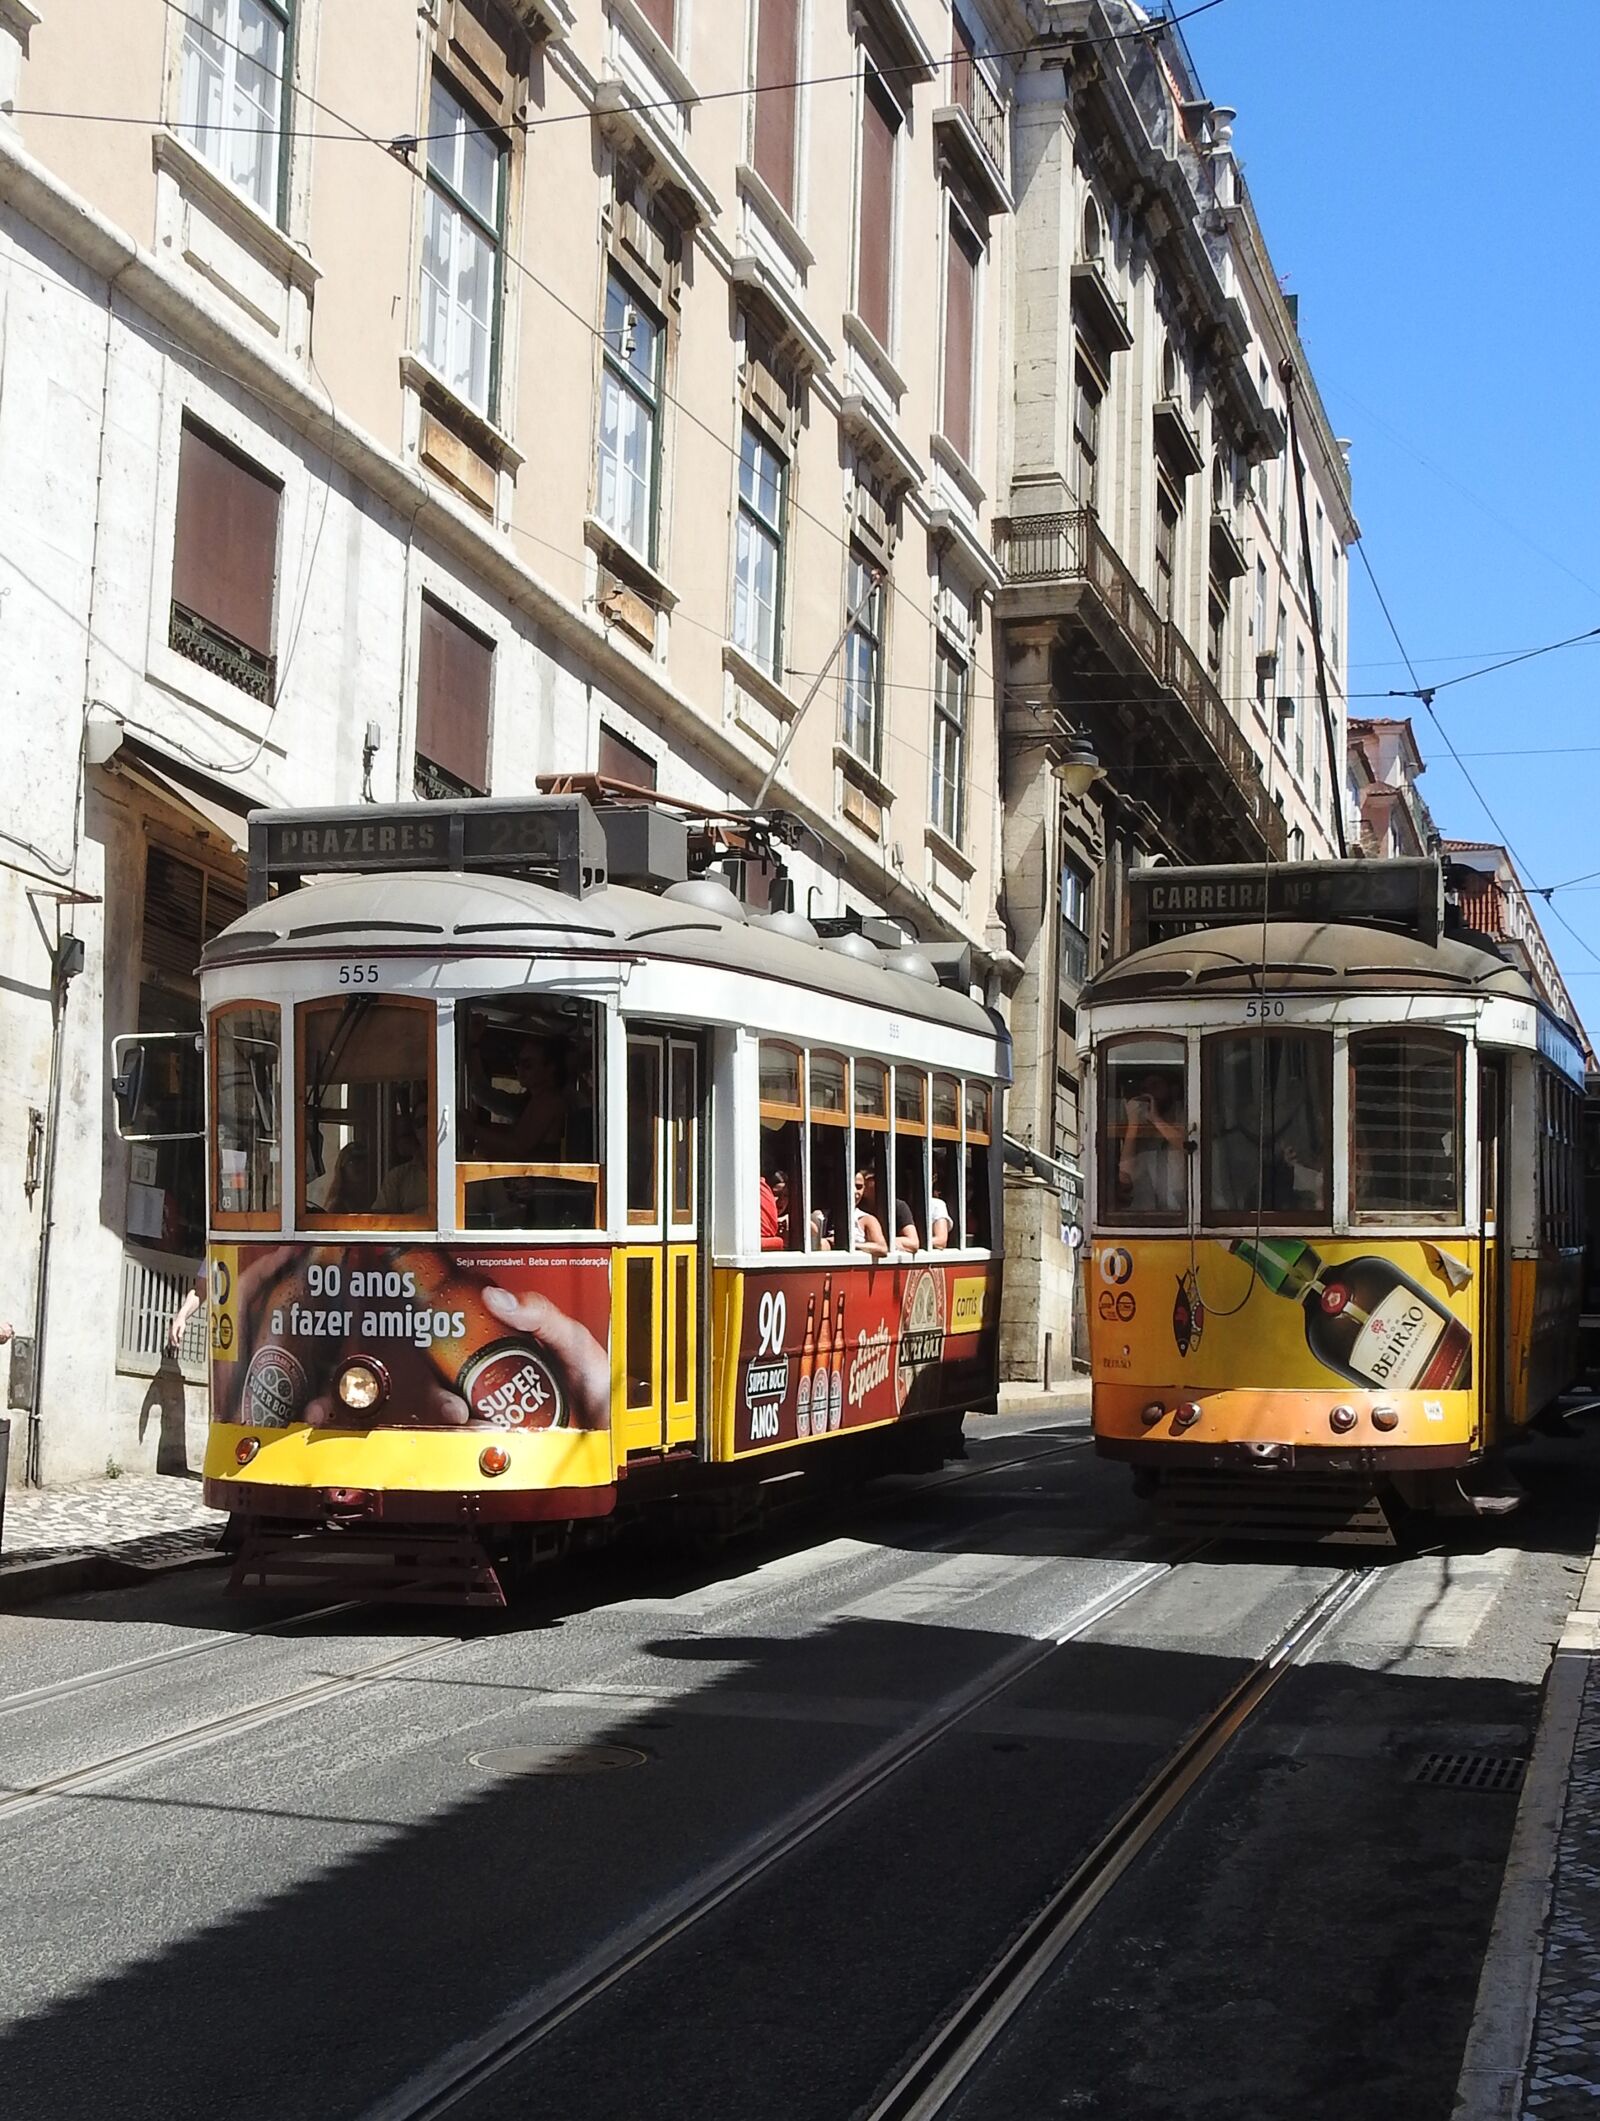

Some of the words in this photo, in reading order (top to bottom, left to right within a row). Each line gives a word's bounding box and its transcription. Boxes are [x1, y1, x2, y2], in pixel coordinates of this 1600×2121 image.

[281, 824, 435, 854] PRAZERES
[490, 817, 545, 852] 28
[1152, 884, 1267, 910] CARREIRA
[338, 964, 380, 985] 555
[1246, 1001, 1285, 1018] 550
[456, 1257, 474, 1267] Seja
[476, 1257, 526, 1267] responsável.
[528, 1257, 549, 1266] Beba
[569, 1257, 608, 1268] moderação
[307, 1264, 341, 1297] 90
[350, 1270, 416, 1298] anos
[271, 1309, 284, 1335] a
[290, 1302, 353, 1336] fazer
[361, 1304, 466, 1348] amigos
[758, 1291, 786, 1356] 90
[1371, 1306, 1424, 1379] BEIRÃO
[249, 1375, 273, 1408] SUPER
[477, 1365, 541, 1418] SUPER
[748, 1371, 769, 1393] SUPER
[769, 1368, 787, 1390] BOCK
[849, 1350, 890, 1408] Especial
[491, 1381, 550, 1430] BOCK
[751, 1403, 779, 1440] ANOS
